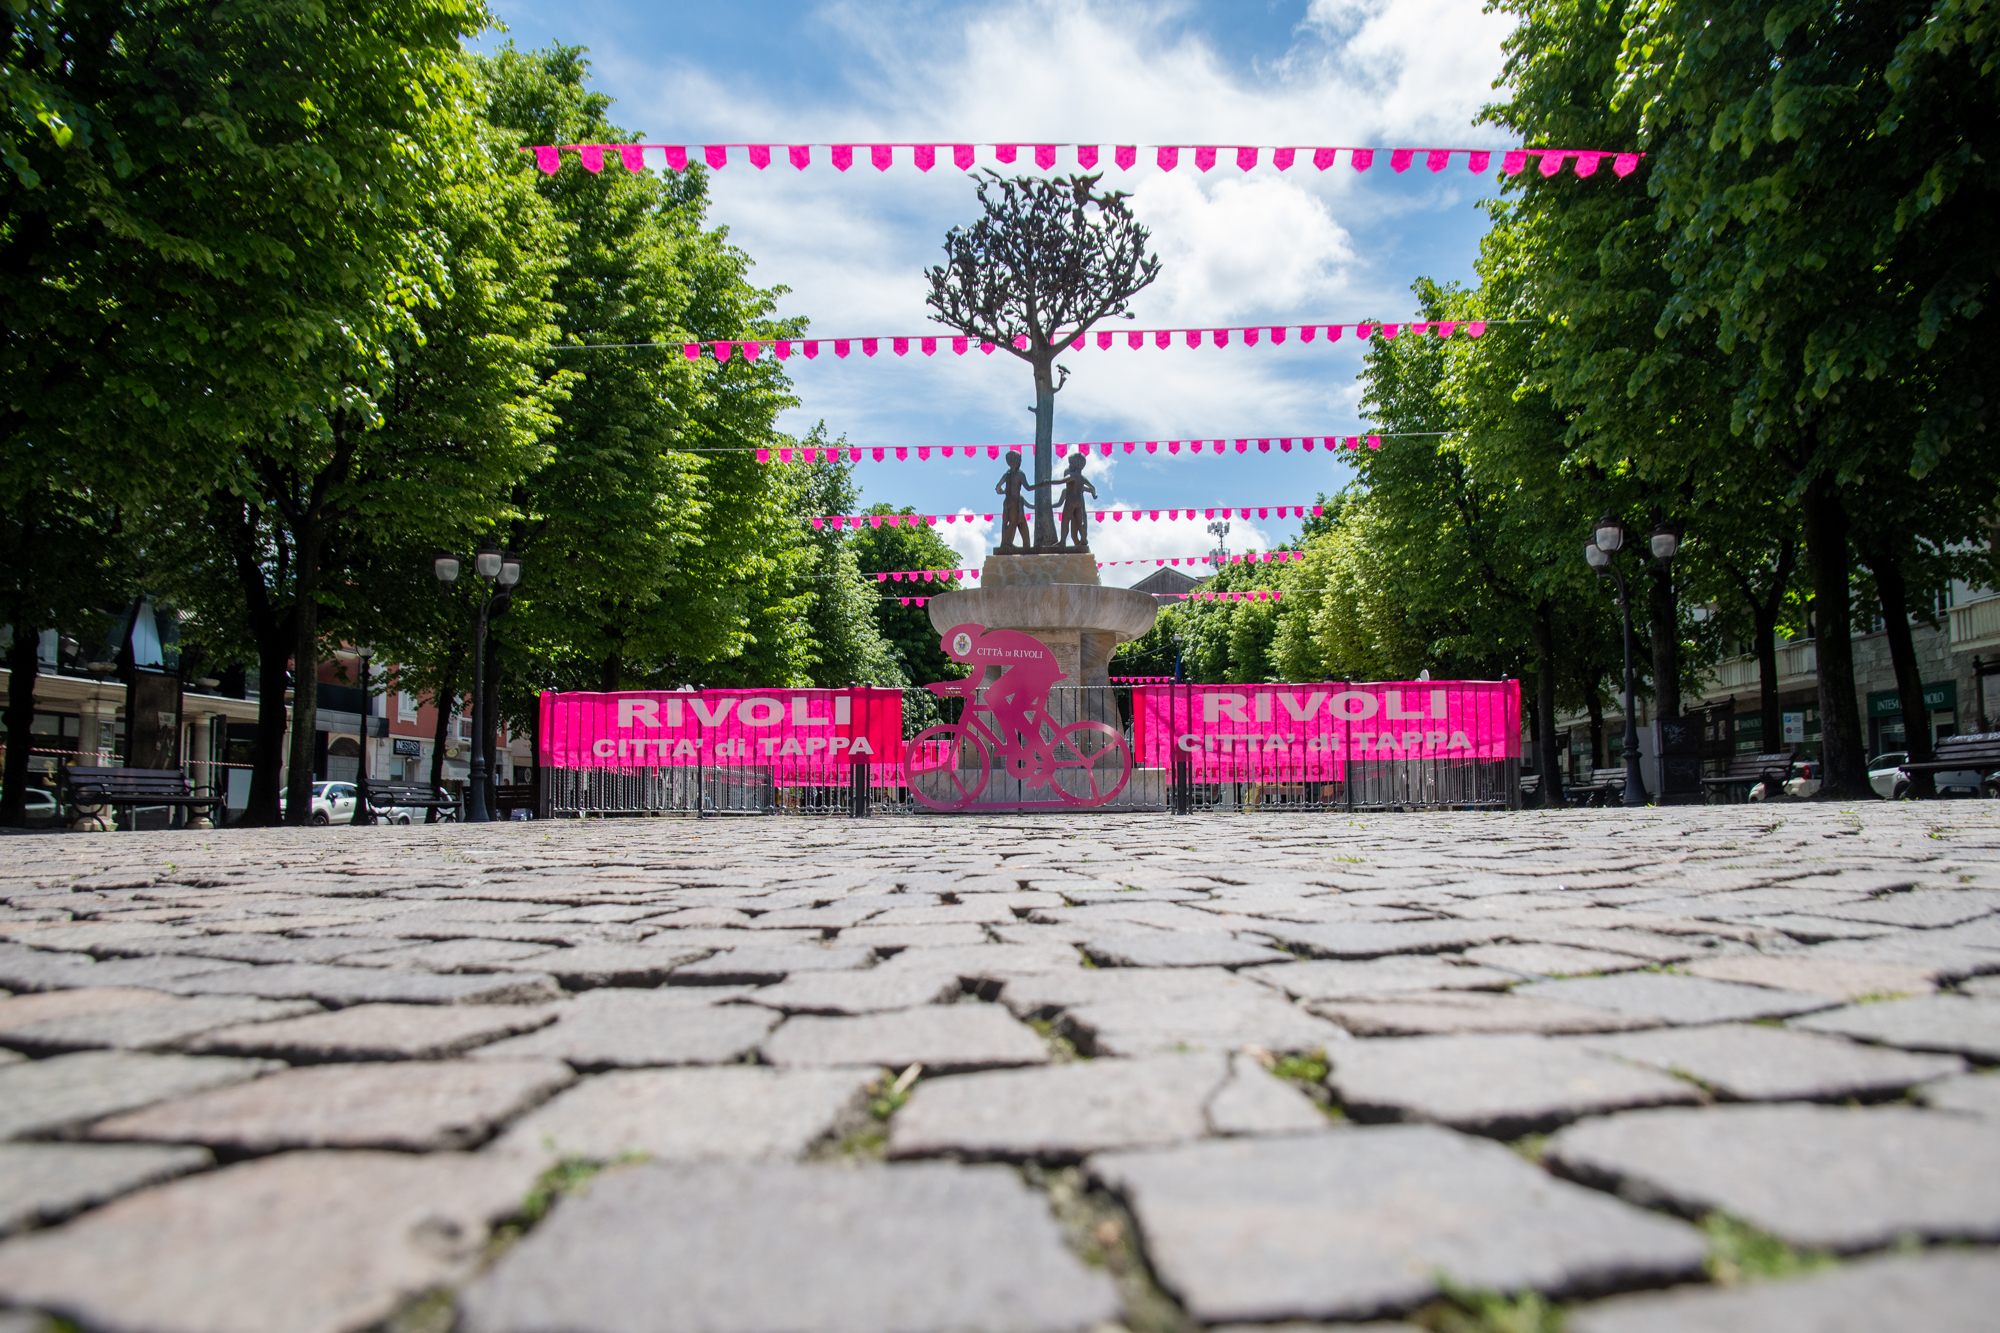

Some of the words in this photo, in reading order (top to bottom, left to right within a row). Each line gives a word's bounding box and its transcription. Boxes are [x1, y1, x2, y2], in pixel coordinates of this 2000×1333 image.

[977, 647, 1003, 657] CITTÀ
[1013, 650, 1043, 659] RIVOLI
[617, 697, 851, 728] RIVOLI
[1203, 690, 1447, 722] RIVOLI
[593, 737, 703, 758] CITTA'
[714, 738, 744, 757] di
[760, 736, 874, 755] TAPPA
[1178, 733, 1295, 752] CITTA'
[1308, 733, 1339, 752] di
[1350, 731, 1473, 751] TAPPA
